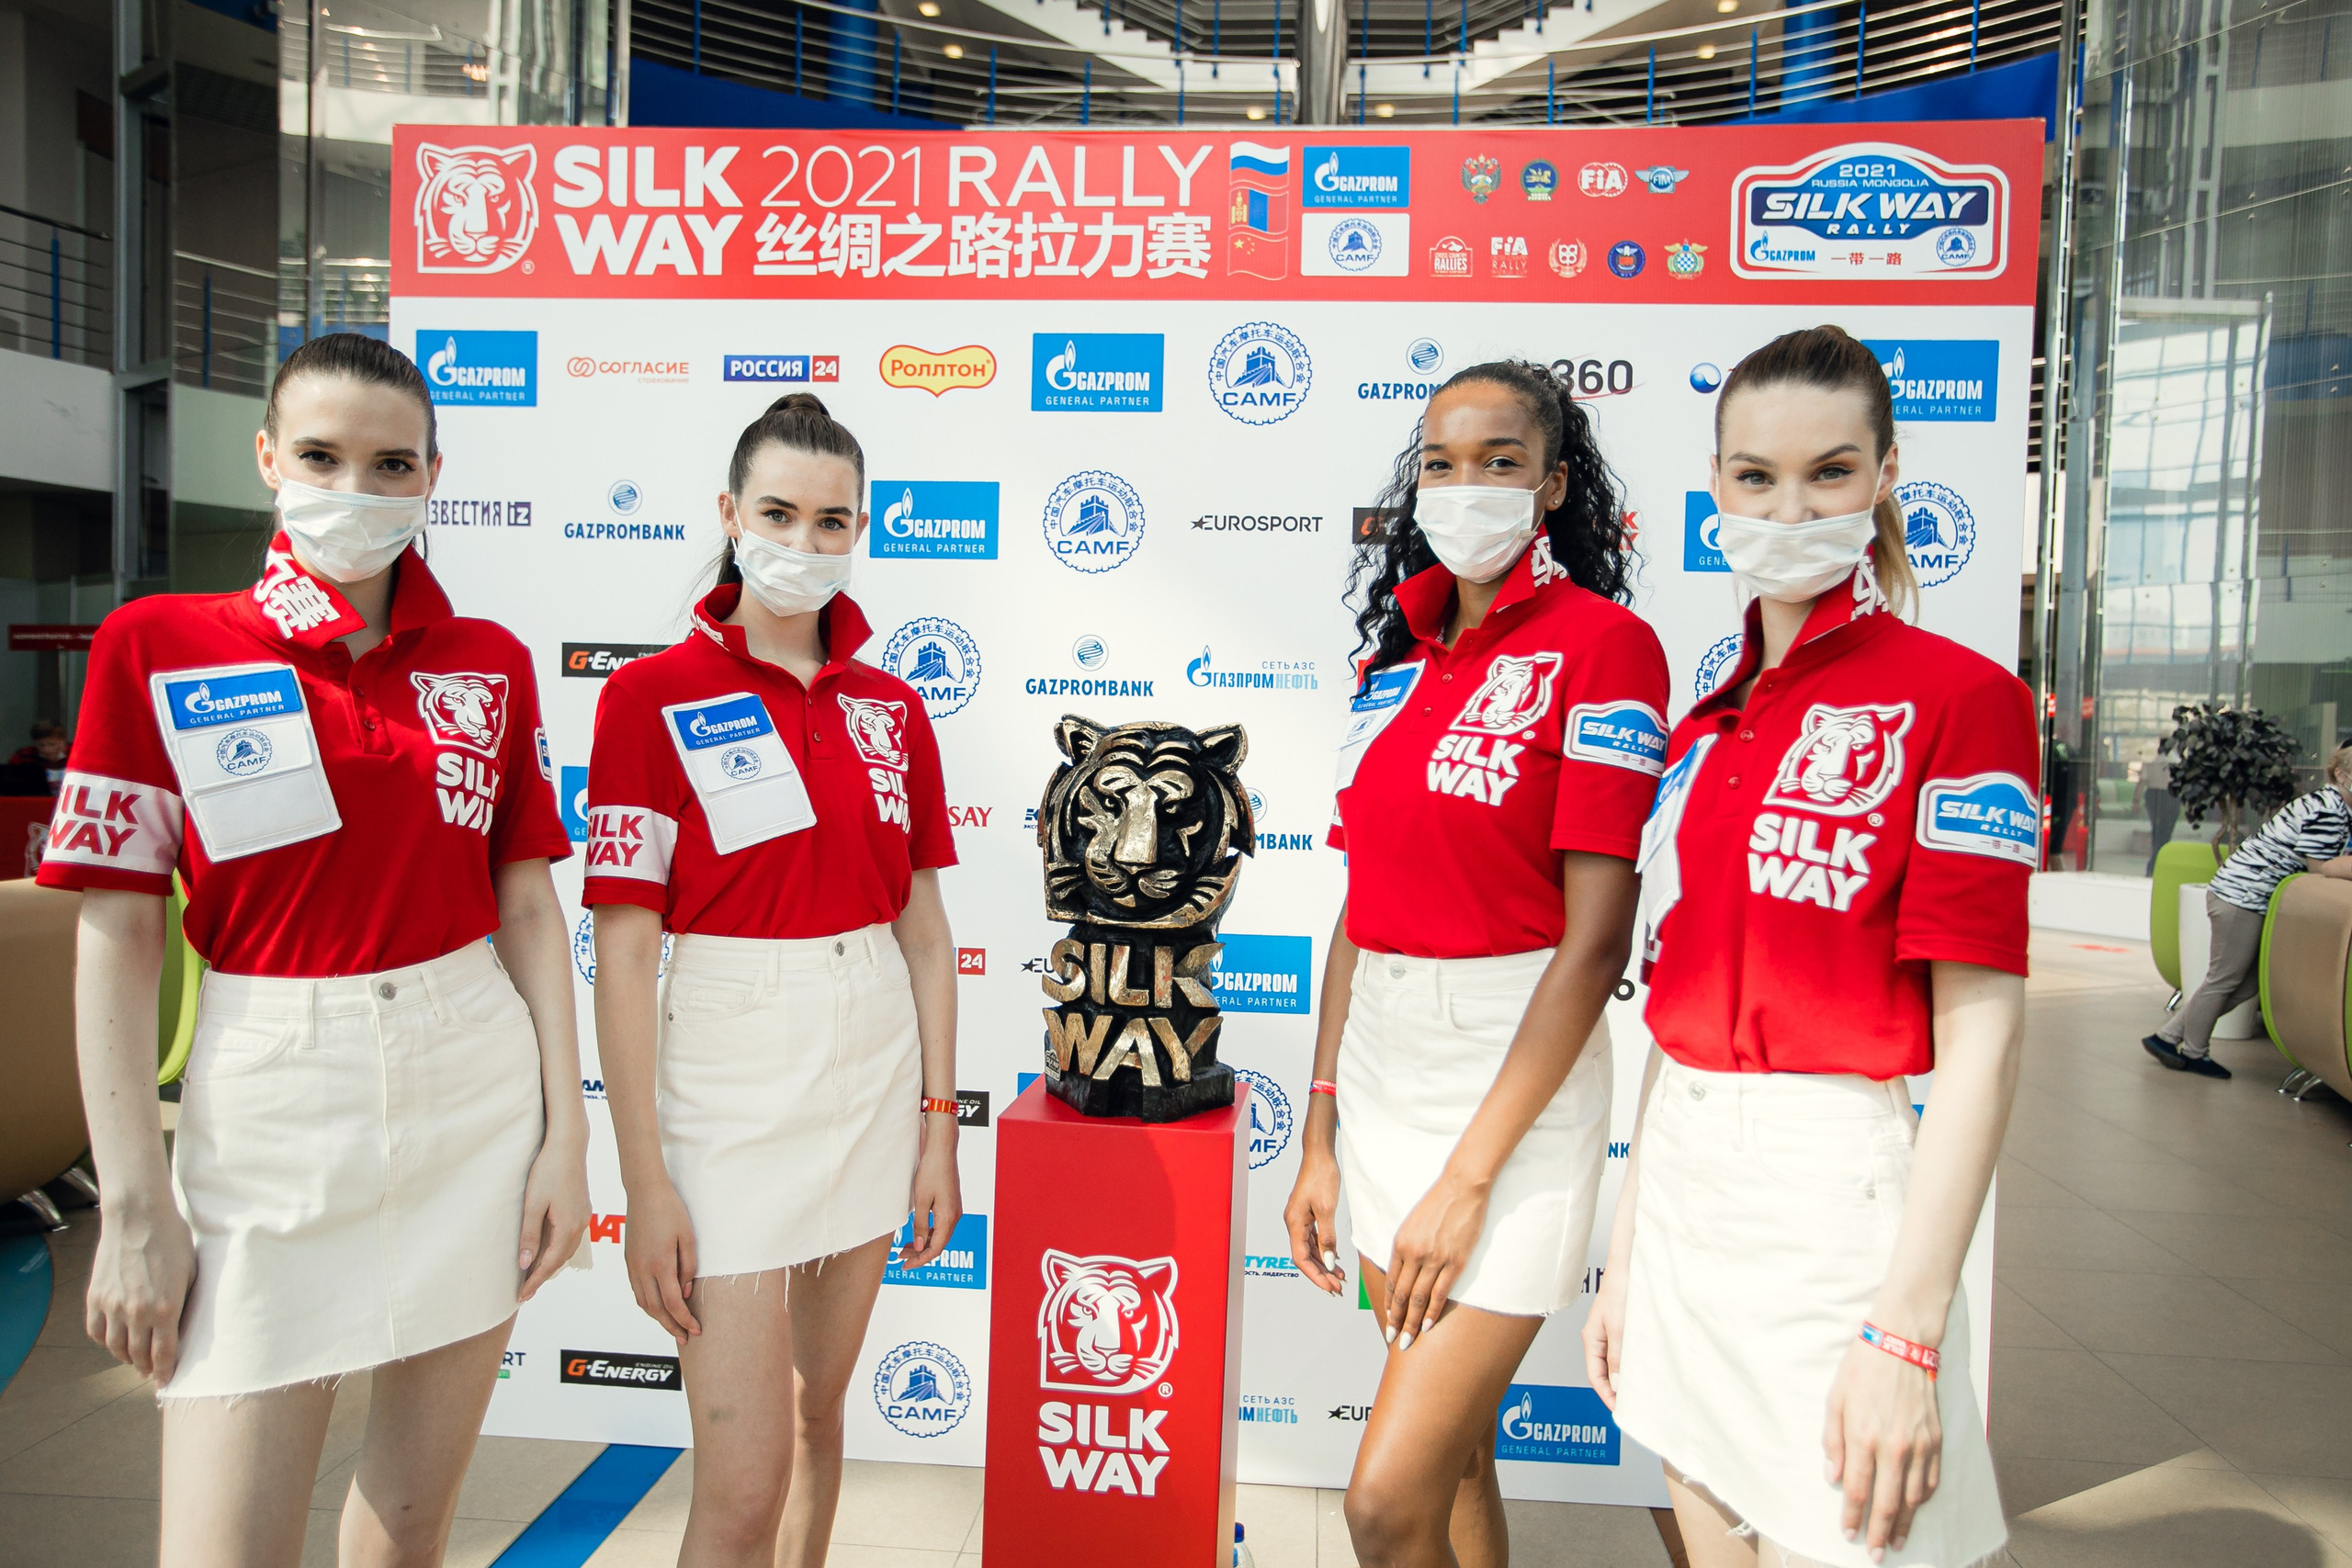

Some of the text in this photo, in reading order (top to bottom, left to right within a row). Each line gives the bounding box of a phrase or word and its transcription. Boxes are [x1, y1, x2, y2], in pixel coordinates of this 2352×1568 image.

[553, 145, 1213, 208] SILK 2021 RALLY
[1839, 164, 1896, 177] 2021
[1340, 175, 1397, 192] GAZPROM
[1654, 174, 1670, 186] FIM
[1811, 179, 1929, 187] RUSSIA MONGOLIA
[1314, 195, 1397, 203] GENERAL PARTNER
[1761, 193, 1978, 220] SILK WAY
[1826, 223, 1912, 235] RALLY
[554, 214, 743, 276] WAY
[753, 212, 1212, 279] 丝绸之路拉力赛
[1336, 254, 1374, 262] CAMF
[1434, 257, 1467, 271] RALLIES
[1770, 250, 1816, 262] GAZPROM
[1492, 261, 1527, 270] RALLY
[599, 361, 689, 374] СОГЛАСИЕ
[730, 360, 837, 377] РОССИЯ 24
[1551, 358, 1634, 395] 360
[457, 367, 526, 387] GAZPROM
[1077, 371, 1149, 391] GAZPROM
[430, 390, 526, 400] GENERAL PARTNER
[1906, 379, 1983, 400] GAZPROM
[1046, 396, 1149, 406] GENERAL PARTNER
[1223, 391, 1297, 407] CAMF
[1893, 405, 1982, 415] ERAL PARTNER
[427, 501, 502, 525] ЗВЕСТИЯ
[564, 523, 685, 540] GAZPROMBANK
[914, 519, 986, 539] GAZPROM
[1203, 514, 1323, 533] EUROSPORT
[884, 543, 985, 554] GENERAL PARTNER
[1057, 540, 1130, 555] CAMF
[1261, 660, 1316, 671] СЕТЬ АЗС
[1025, 678, 1154, 697] GAZPROMBANK
[215, 690, 283, 712] GAZPROM
[189, 704, 285, 725] GENERAL PARTNER
[711, 715, 758, 735] GAZPROM
[695, 728, 761, 746] GENERAL PARTNER
[1580, 721, 1666, 751] SILK WAY
[1432, 734, 1525, 777] SILK
[1612, 740, 1650, 753] RALLY
[227, 755, 267, 771] CAMF
[730, 765, 759, 777] CAMF
[1427, 761, 1517, 807] WAY
[60, 784, 142, 825] ILK
[1938, 800, 2036, 834] SILK WAY
[1980, 824, 2023, 837] RALLY
[1748, 813, 1877, 874] SILK
[1747, 852, 1869, 912] WAY
[960, 953, 983, 969] 24
[1042, 938, 1226, 1009] SILK
[1224, 972, 1297, 993] GAZPROM
[1248, 997, 1297, 1008] PARTNER
[1042, 1007, 1224, 1087] WAY
[926, 1271, 974, 1282] PARTNER
[1242, 1394, 1295, 1405] СЕТЬ АЗС
[888, 1404, 956, 1422] CAMF
[1038, 1401, 1170, 1451] SILK
[1532, 1422, 1607, 1445] GAZPROM
[1500, 1445, 1607, 1460] GENERAL PARTNER
[1038, 1446, 1170, 1496] WAY
